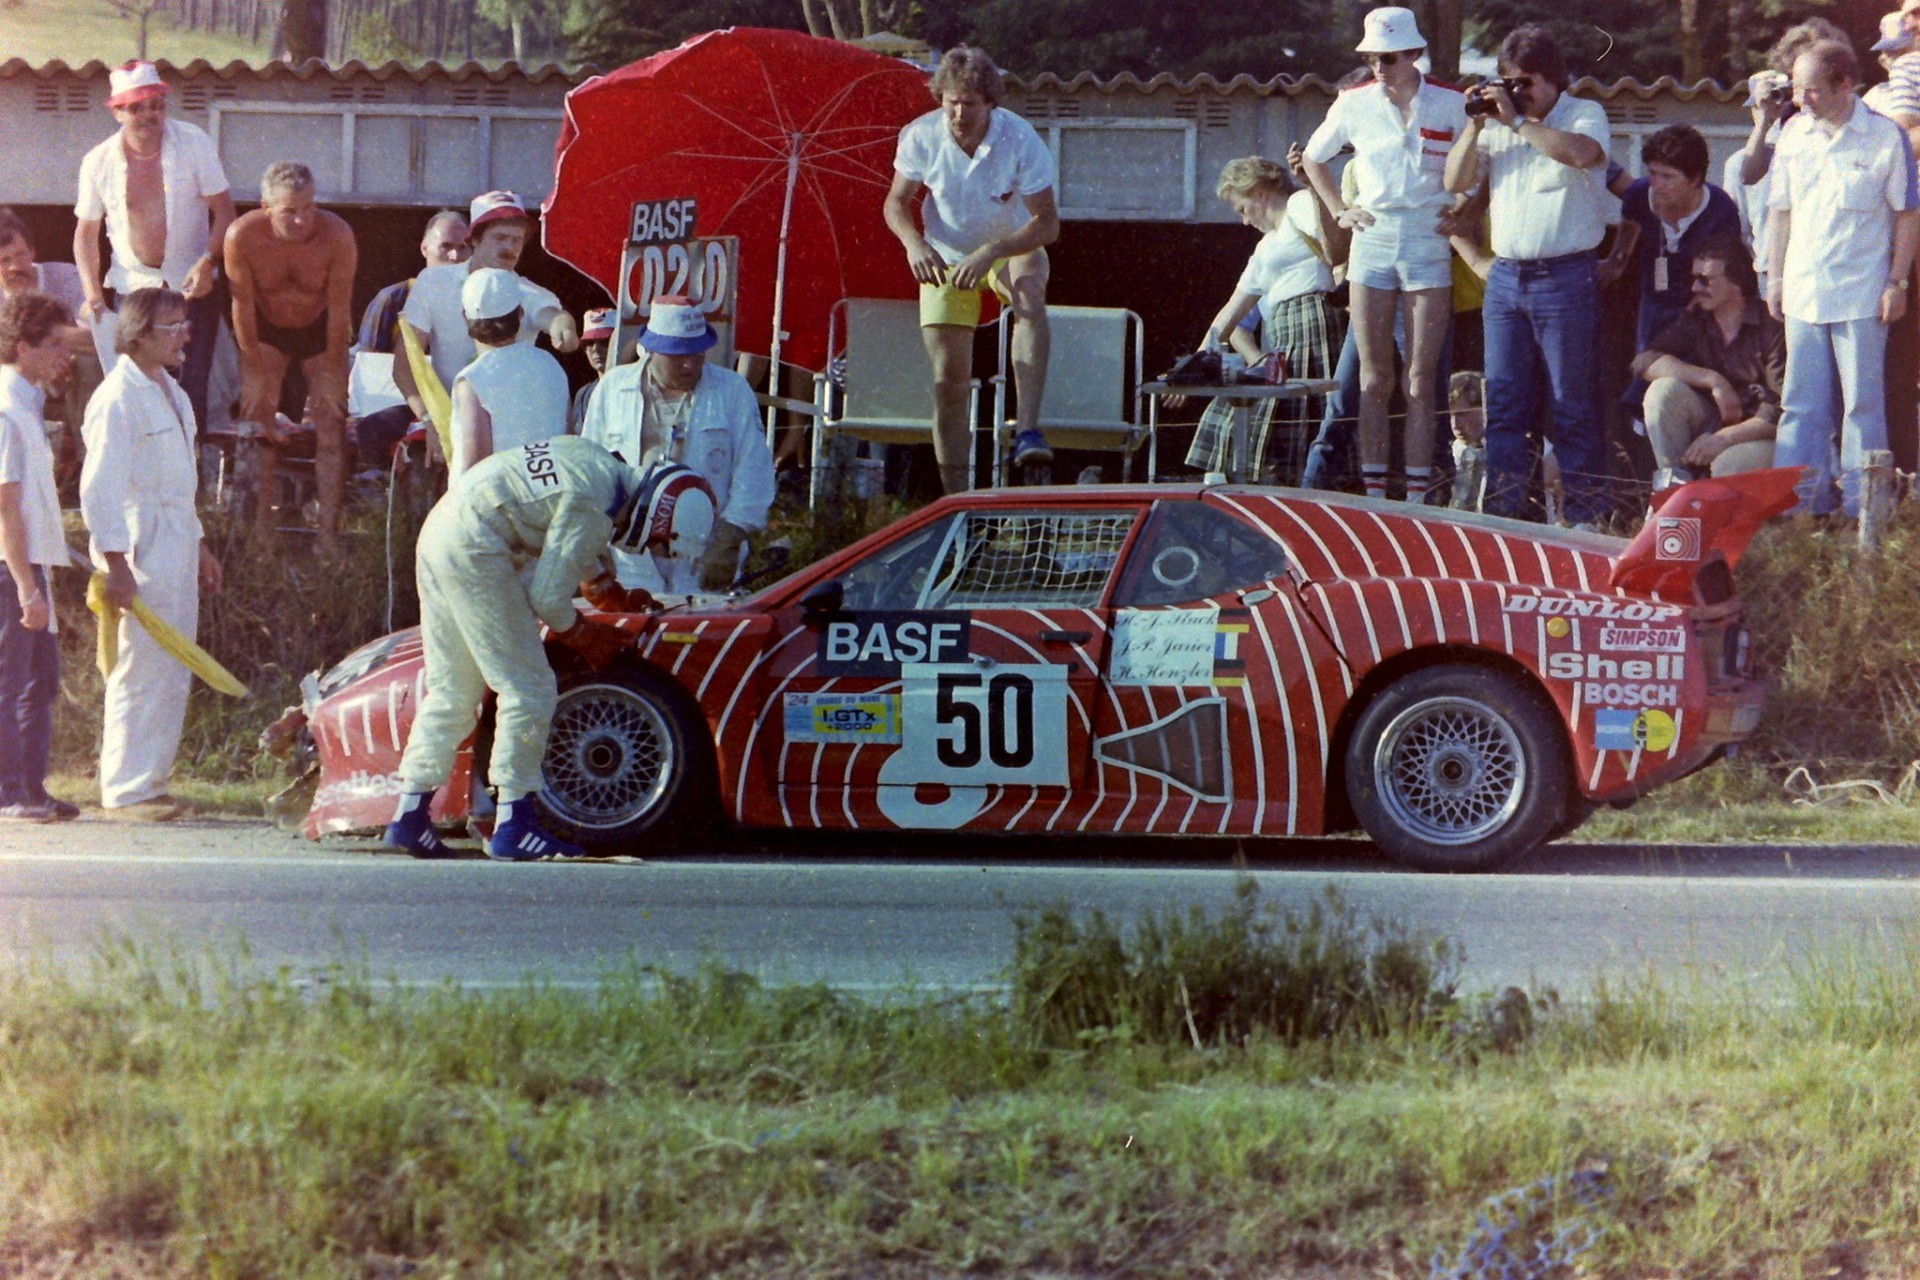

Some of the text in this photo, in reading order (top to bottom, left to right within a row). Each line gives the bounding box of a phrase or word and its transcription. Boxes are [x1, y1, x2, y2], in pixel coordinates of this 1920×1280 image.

[632, 200, 696, 241] BASF
[523, 441, 560, 488] BASF
[652, 494, 677, 536] BOSS
[1503, 594, 1683, 622] DUNLOP
[826, 621, 962, 663] BASF
[1605, 629, 1681, 648] SIMPSON
[1550, 652, 1685, 680] Shell
[788, 694, 809, 707] 24
[1584, 682, 1678, 706] BOSCH
[936, 672, 1034, 769] 50
